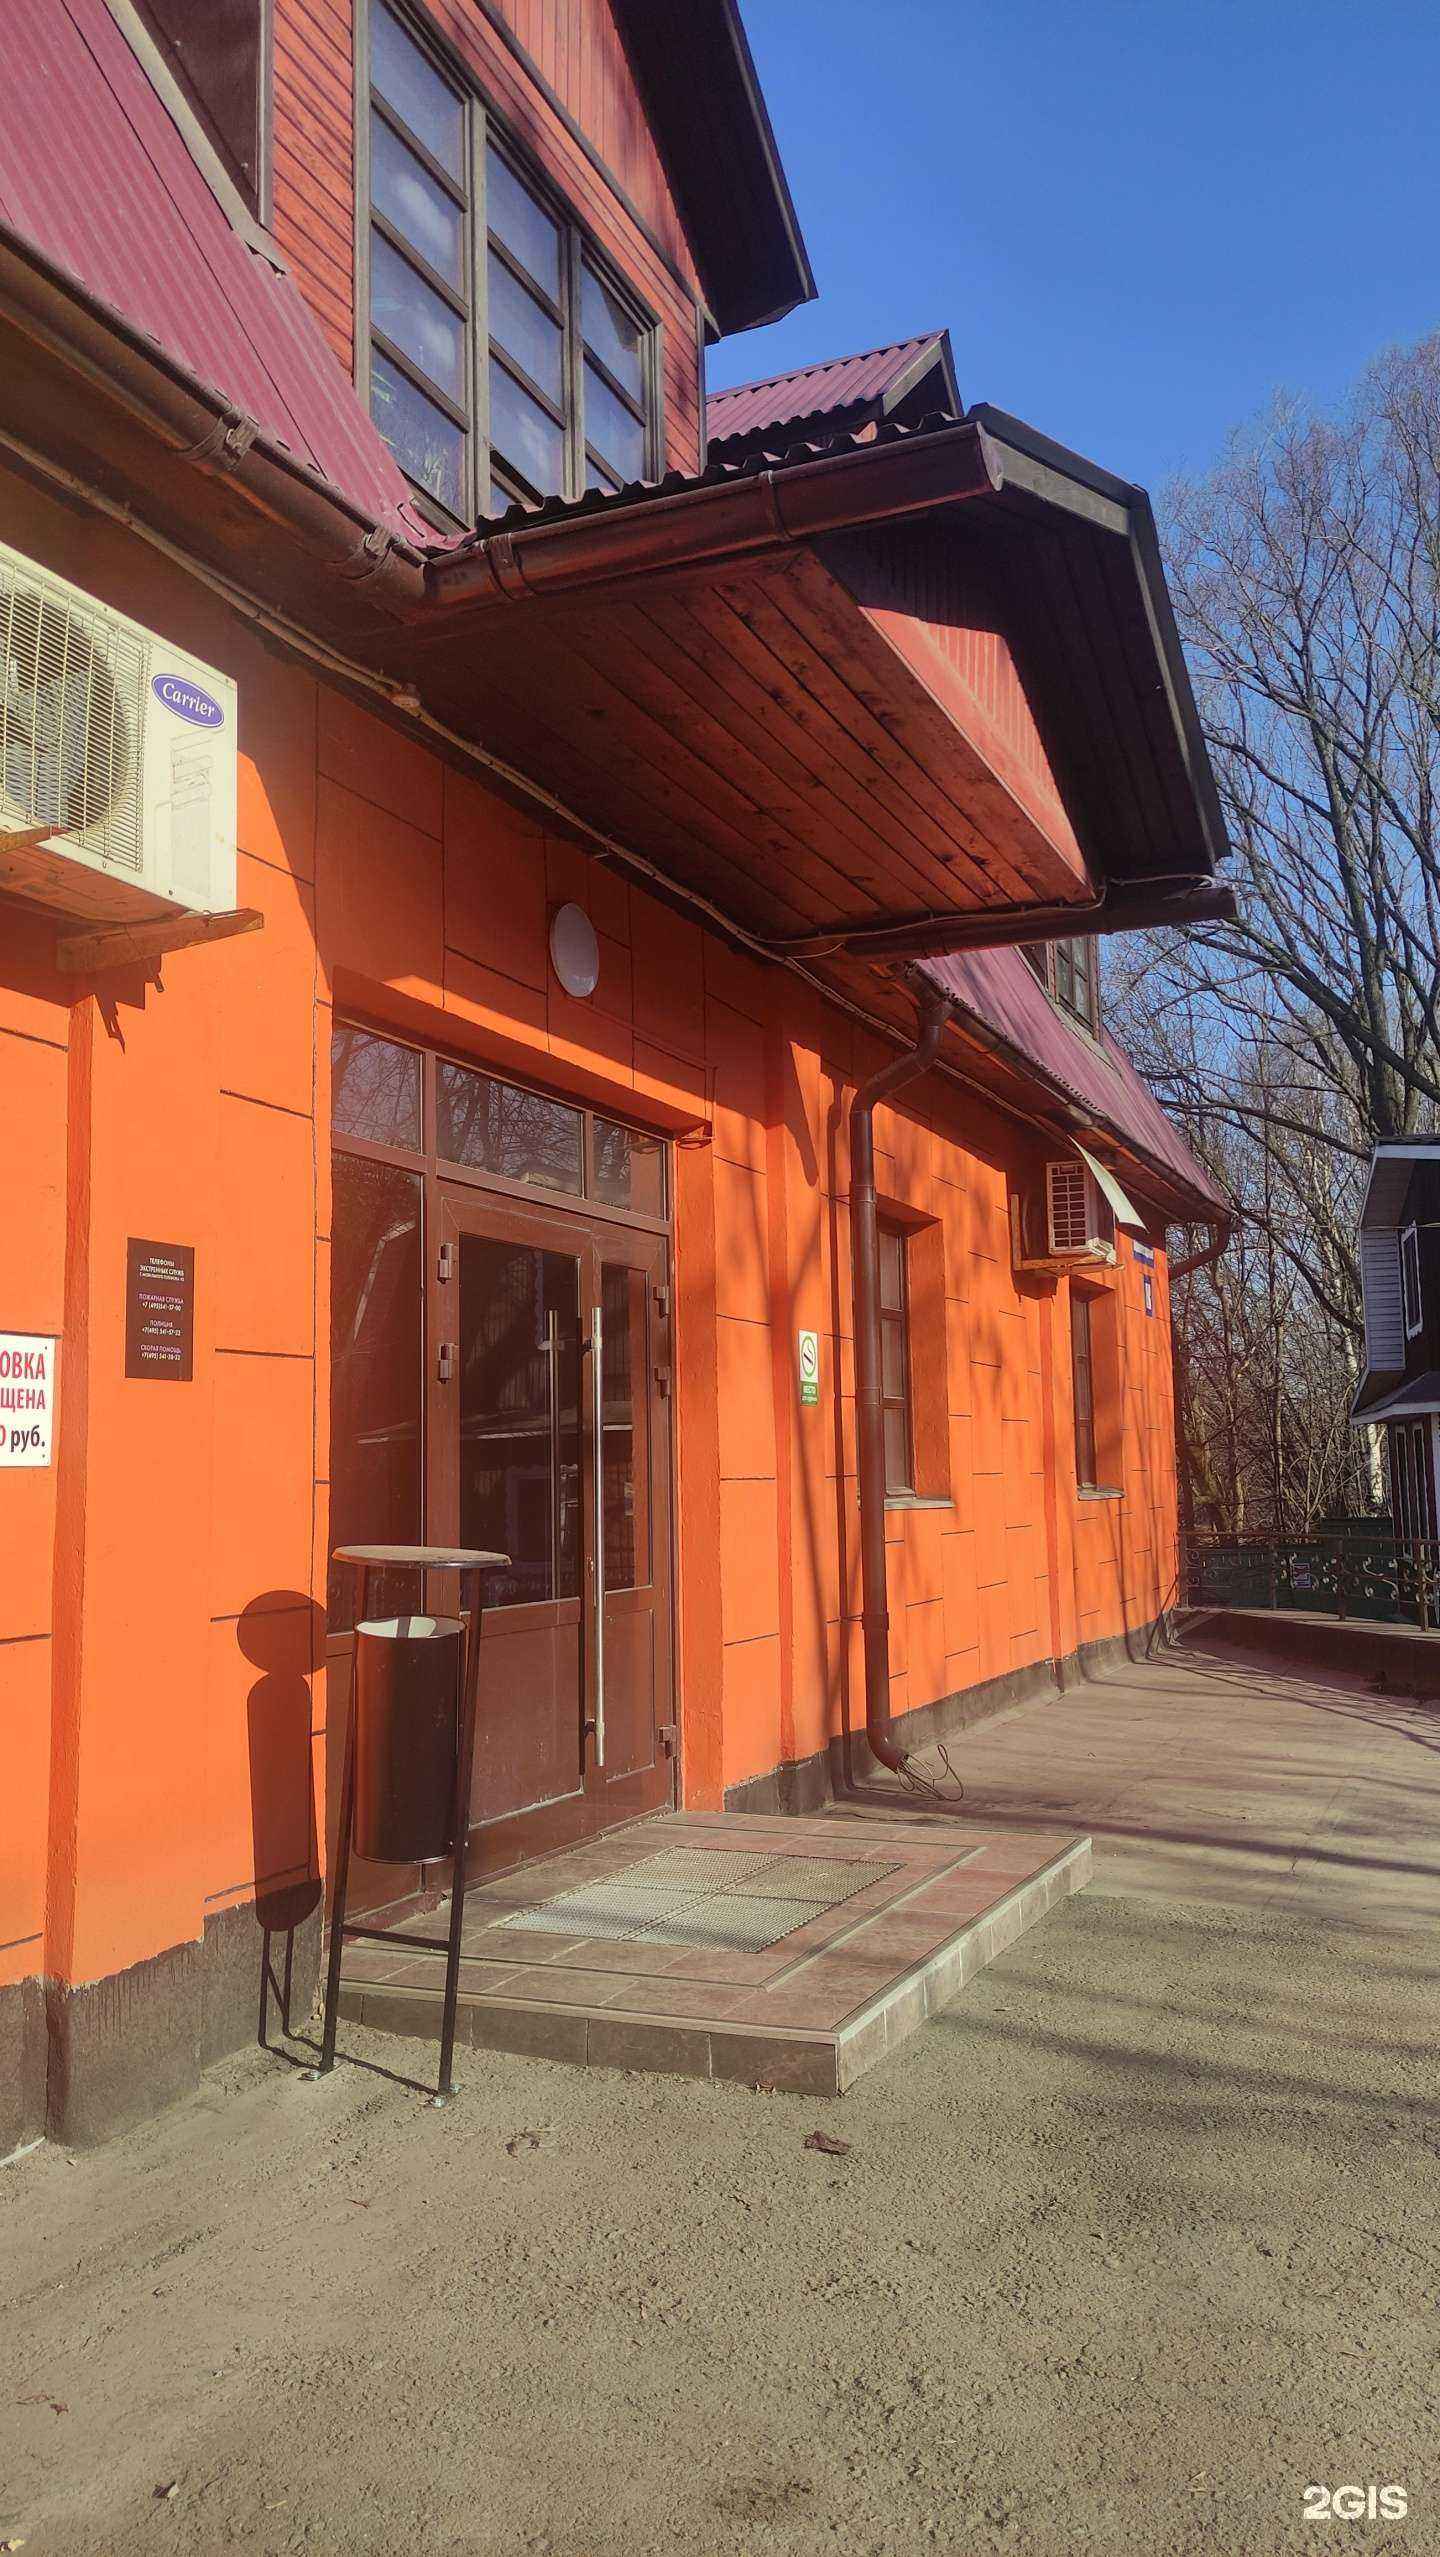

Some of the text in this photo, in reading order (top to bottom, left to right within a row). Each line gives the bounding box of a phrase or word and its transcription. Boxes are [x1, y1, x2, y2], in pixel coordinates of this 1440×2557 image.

[162, 682, 215, 719] Carrier
[0, 1387, 46, 1413] ЩЕНА
[10, 1424, 45, 1453] руб.
